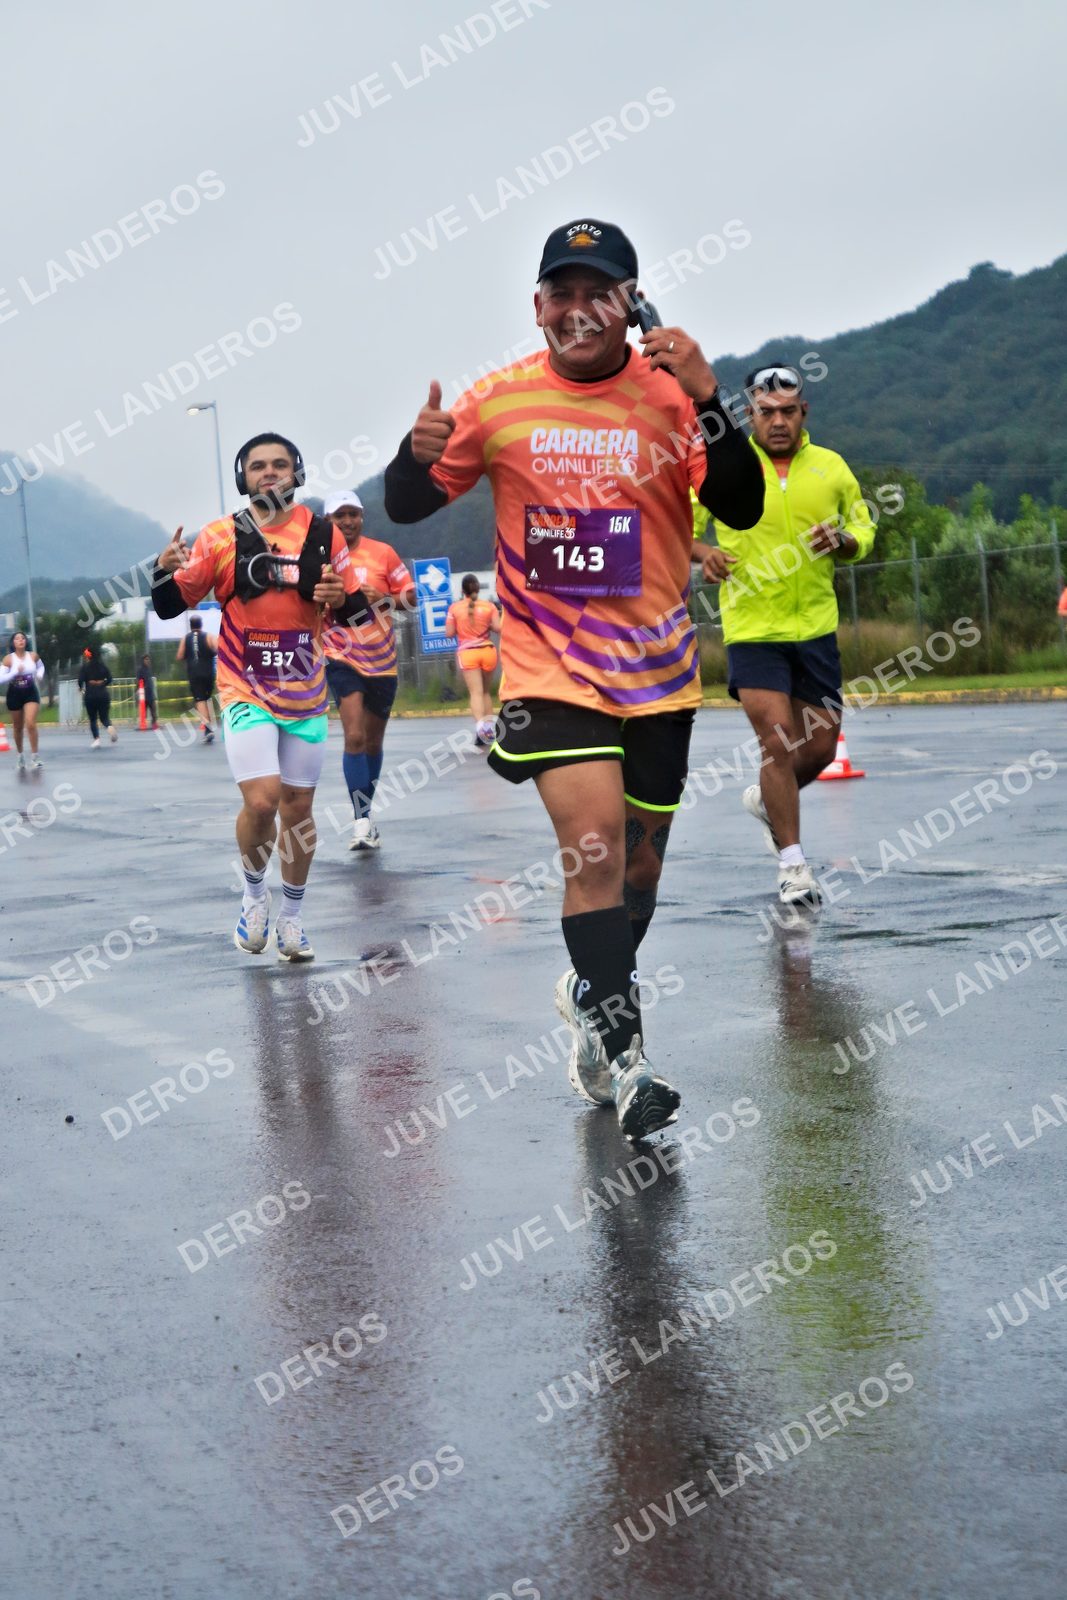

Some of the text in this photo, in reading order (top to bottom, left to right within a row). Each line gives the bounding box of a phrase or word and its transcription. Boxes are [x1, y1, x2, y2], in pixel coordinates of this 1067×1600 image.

[566, 223, 602, 236] KYOTO
[531, 427, 638, 455] CARRERA
[609, 516, 631, 534] 15K
[552, 545, 605, 572] 143
[424, 600, 448, 633] E
[424, 638, 457, 650] ENTRADA
[262, 650, 294, 667] 337
